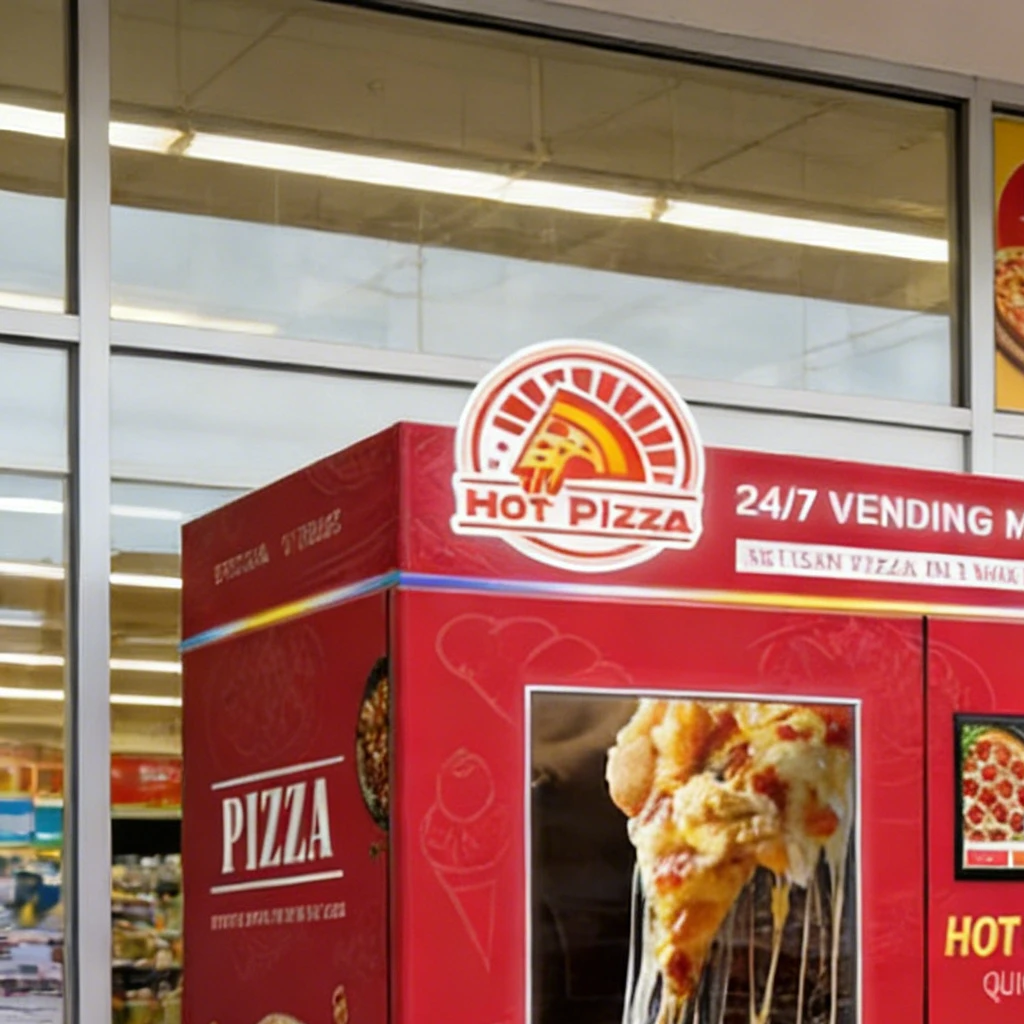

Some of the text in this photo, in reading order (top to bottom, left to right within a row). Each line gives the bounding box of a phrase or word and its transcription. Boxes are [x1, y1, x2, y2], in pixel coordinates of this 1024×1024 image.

[465, 489, 693, 534] HOT PIZZA
[735, 484, 818, 522] 24/7
[828, 490, 994, 537] VENDING
[221, 776, 333, 875] PIZZA
[944, 915, 1021, 957] HOT
